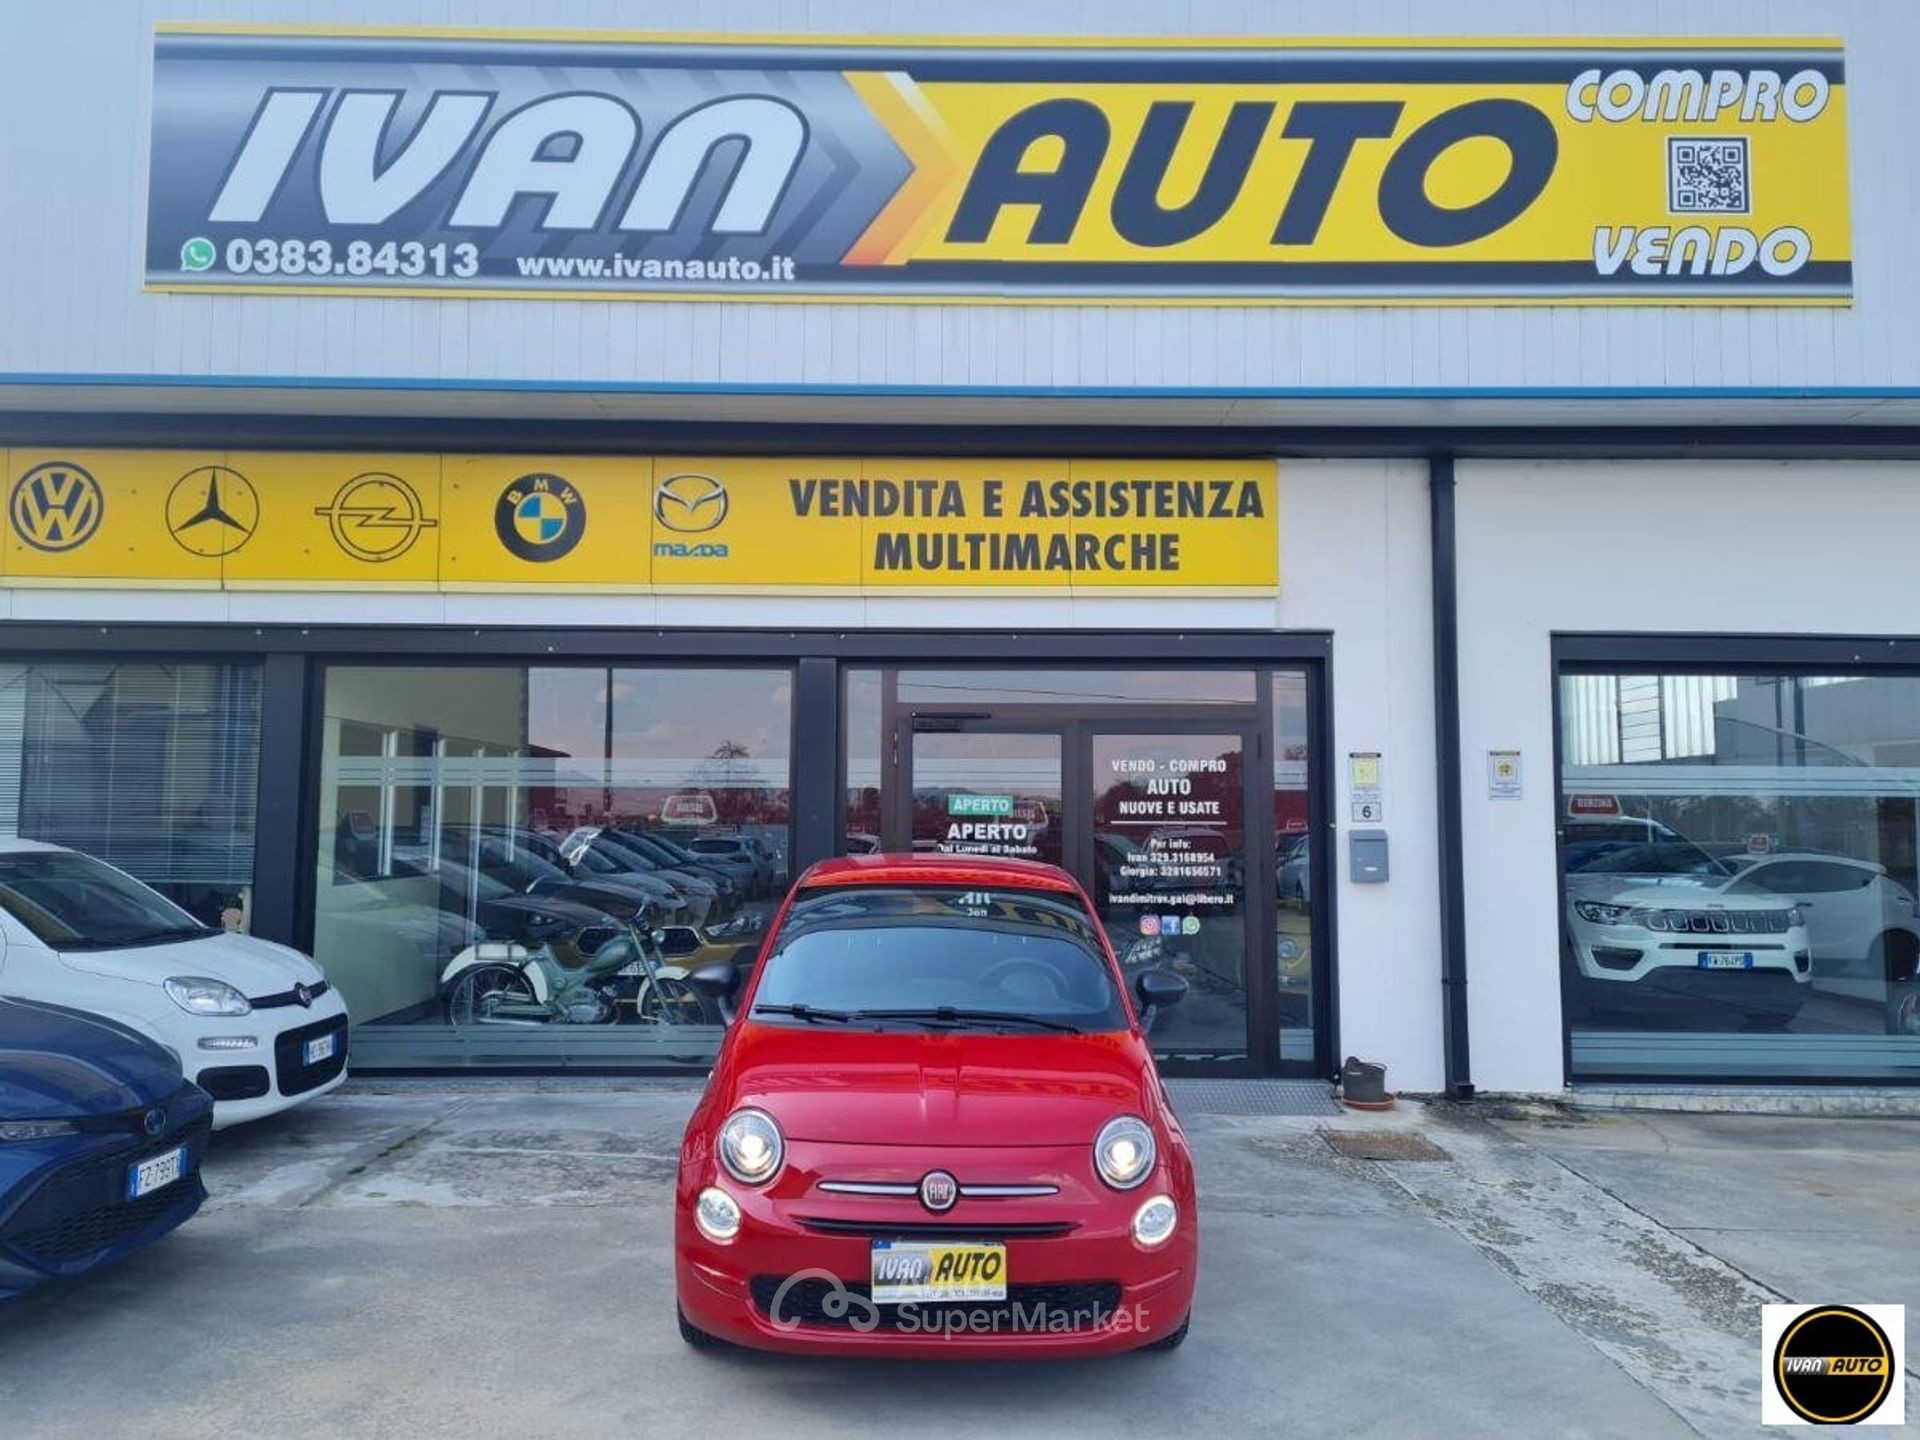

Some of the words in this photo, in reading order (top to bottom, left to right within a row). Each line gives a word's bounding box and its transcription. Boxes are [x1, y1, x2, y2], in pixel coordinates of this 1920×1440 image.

[1565, 69, 1830, 123] COMPRO
[207, 86, 811, 236] IVAN
[943, 97, 1559, 248] AUTO
[225, 238, 479, 277] 0383.84313
[1593, 225, 1812, 277] VENDO
[516, 252, 796, 281] www.ivanauto.it
[506, 477, 578, 506] BMW
[789, 479, 966, 517] VENDITA
[983, 480, 1003, 517] E
[1019, 480, 1265, 518] ASSISTENZA
[874, 533, 1180, 571] MULTIMARCHE
[1111, 760, 1155, 772] VENDO
[1169, 760, 1227, 772] COMPRO
[1147, 779, 1192, 795] AUTO
[953, 799, 1009, 812] APERTO
[1119, 801, 1163, 814] NUOVE
[1167, 802, 1176, 814] E
[1180, 801, 1220, 814] USATE
[1362, 805, 1371, 818] 6
[946, 823, 1027, 840] APERTO
[929, 1183, 948, 1200] FIAT
[878, 1256, 923, 1281] IVAN
[934, 1252, 1001, 1282] AUTO
